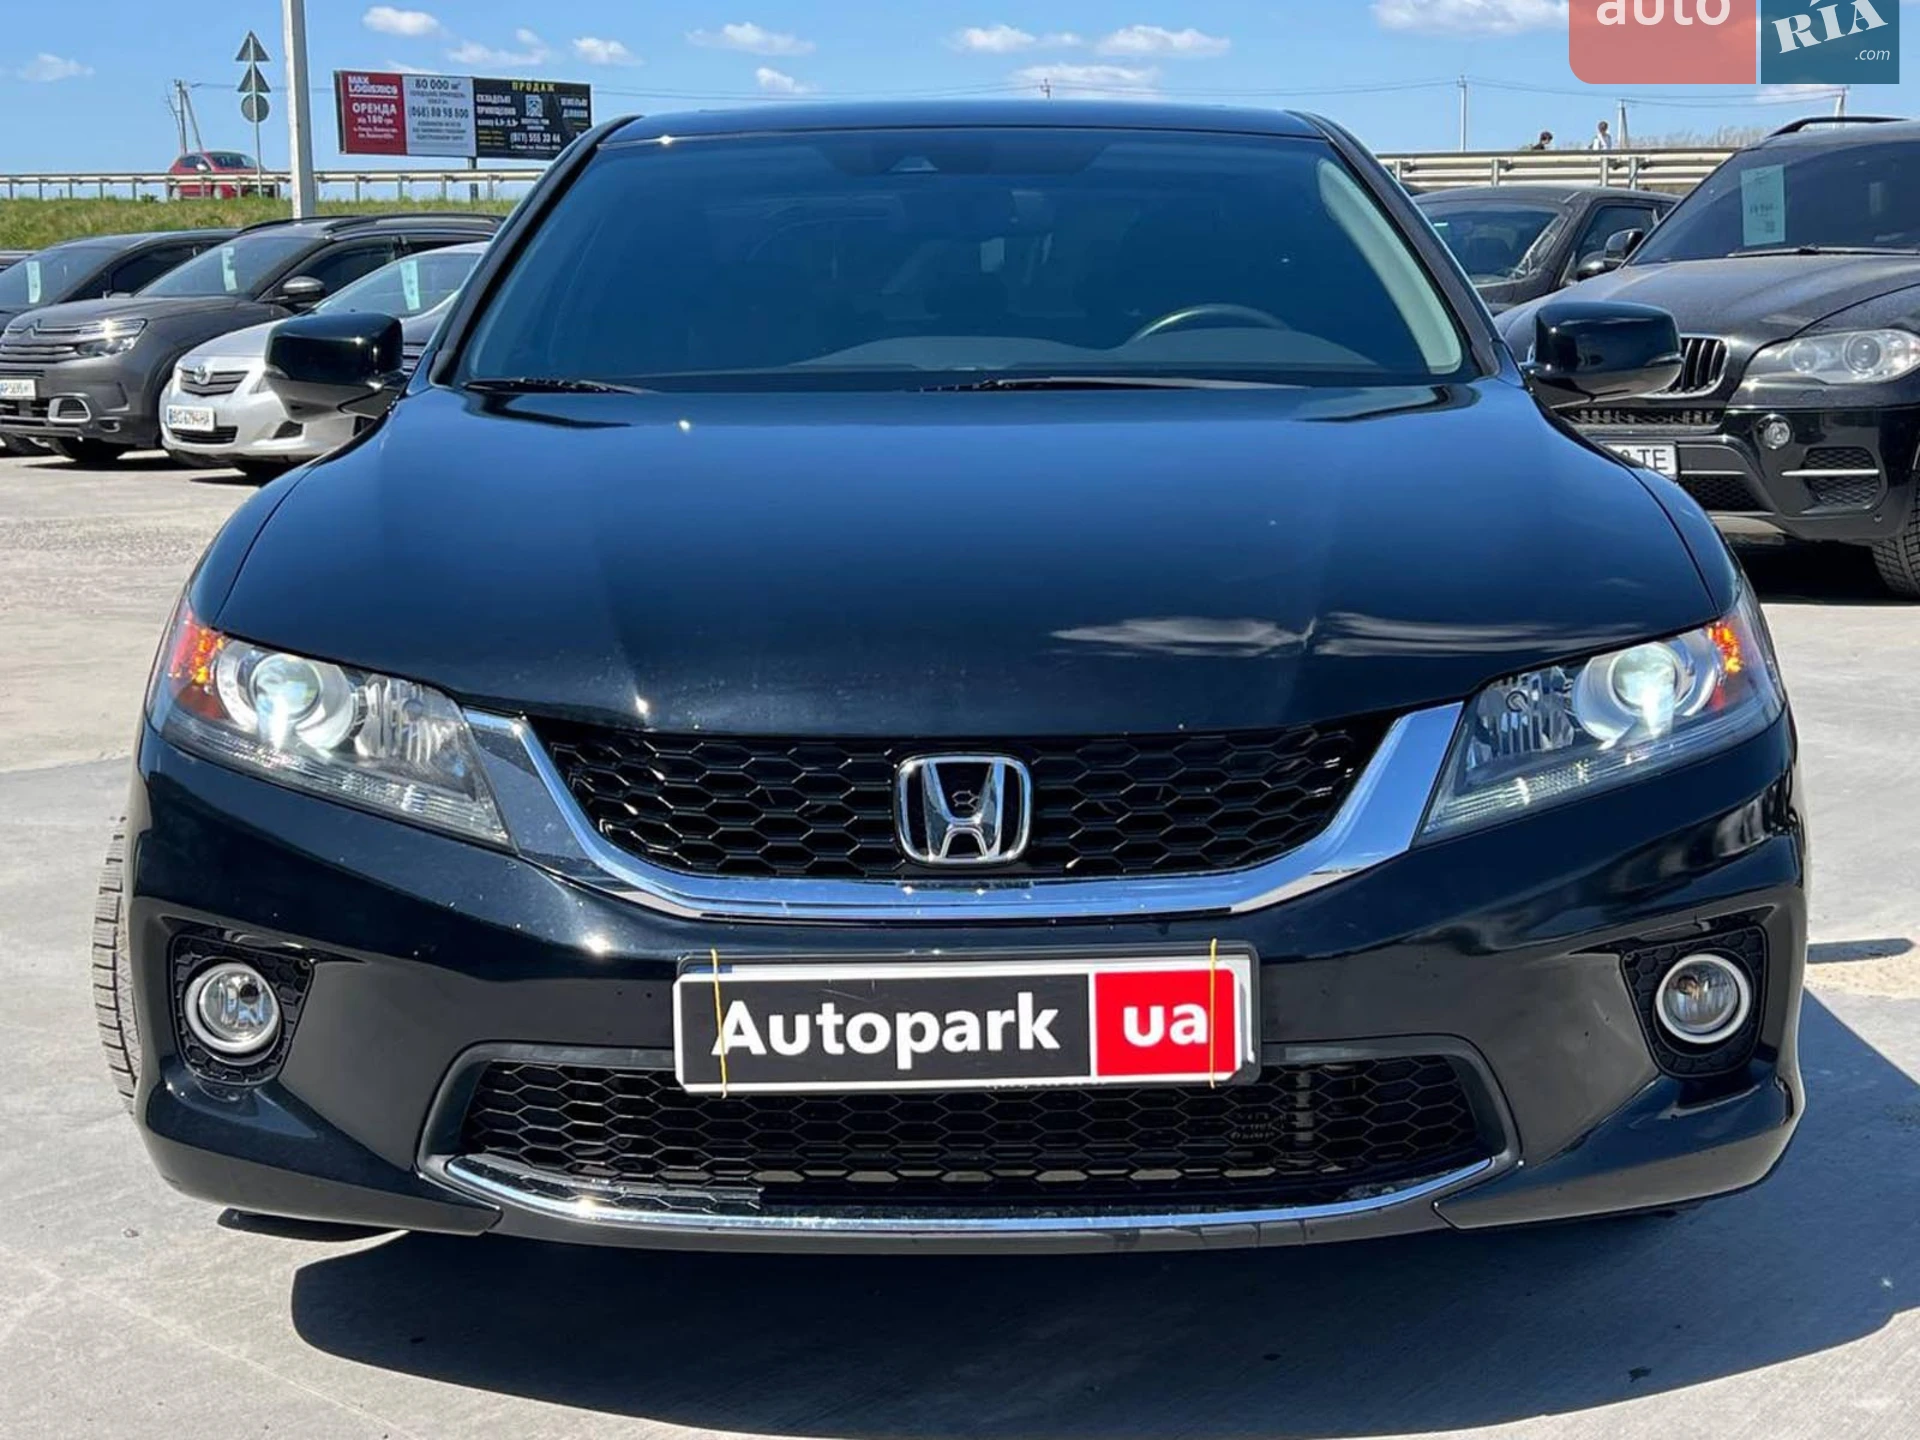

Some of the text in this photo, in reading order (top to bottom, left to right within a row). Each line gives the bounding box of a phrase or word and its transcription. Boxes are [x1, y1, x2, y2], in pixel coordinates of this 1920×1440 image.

[348, 76, 370, 85] MAX
[511, 81, 555, 92] ПРОДАЖ
[352, 102, 397, 116] ОРЕНДА
[711, 991, 1208, 1070] Autopark ua
